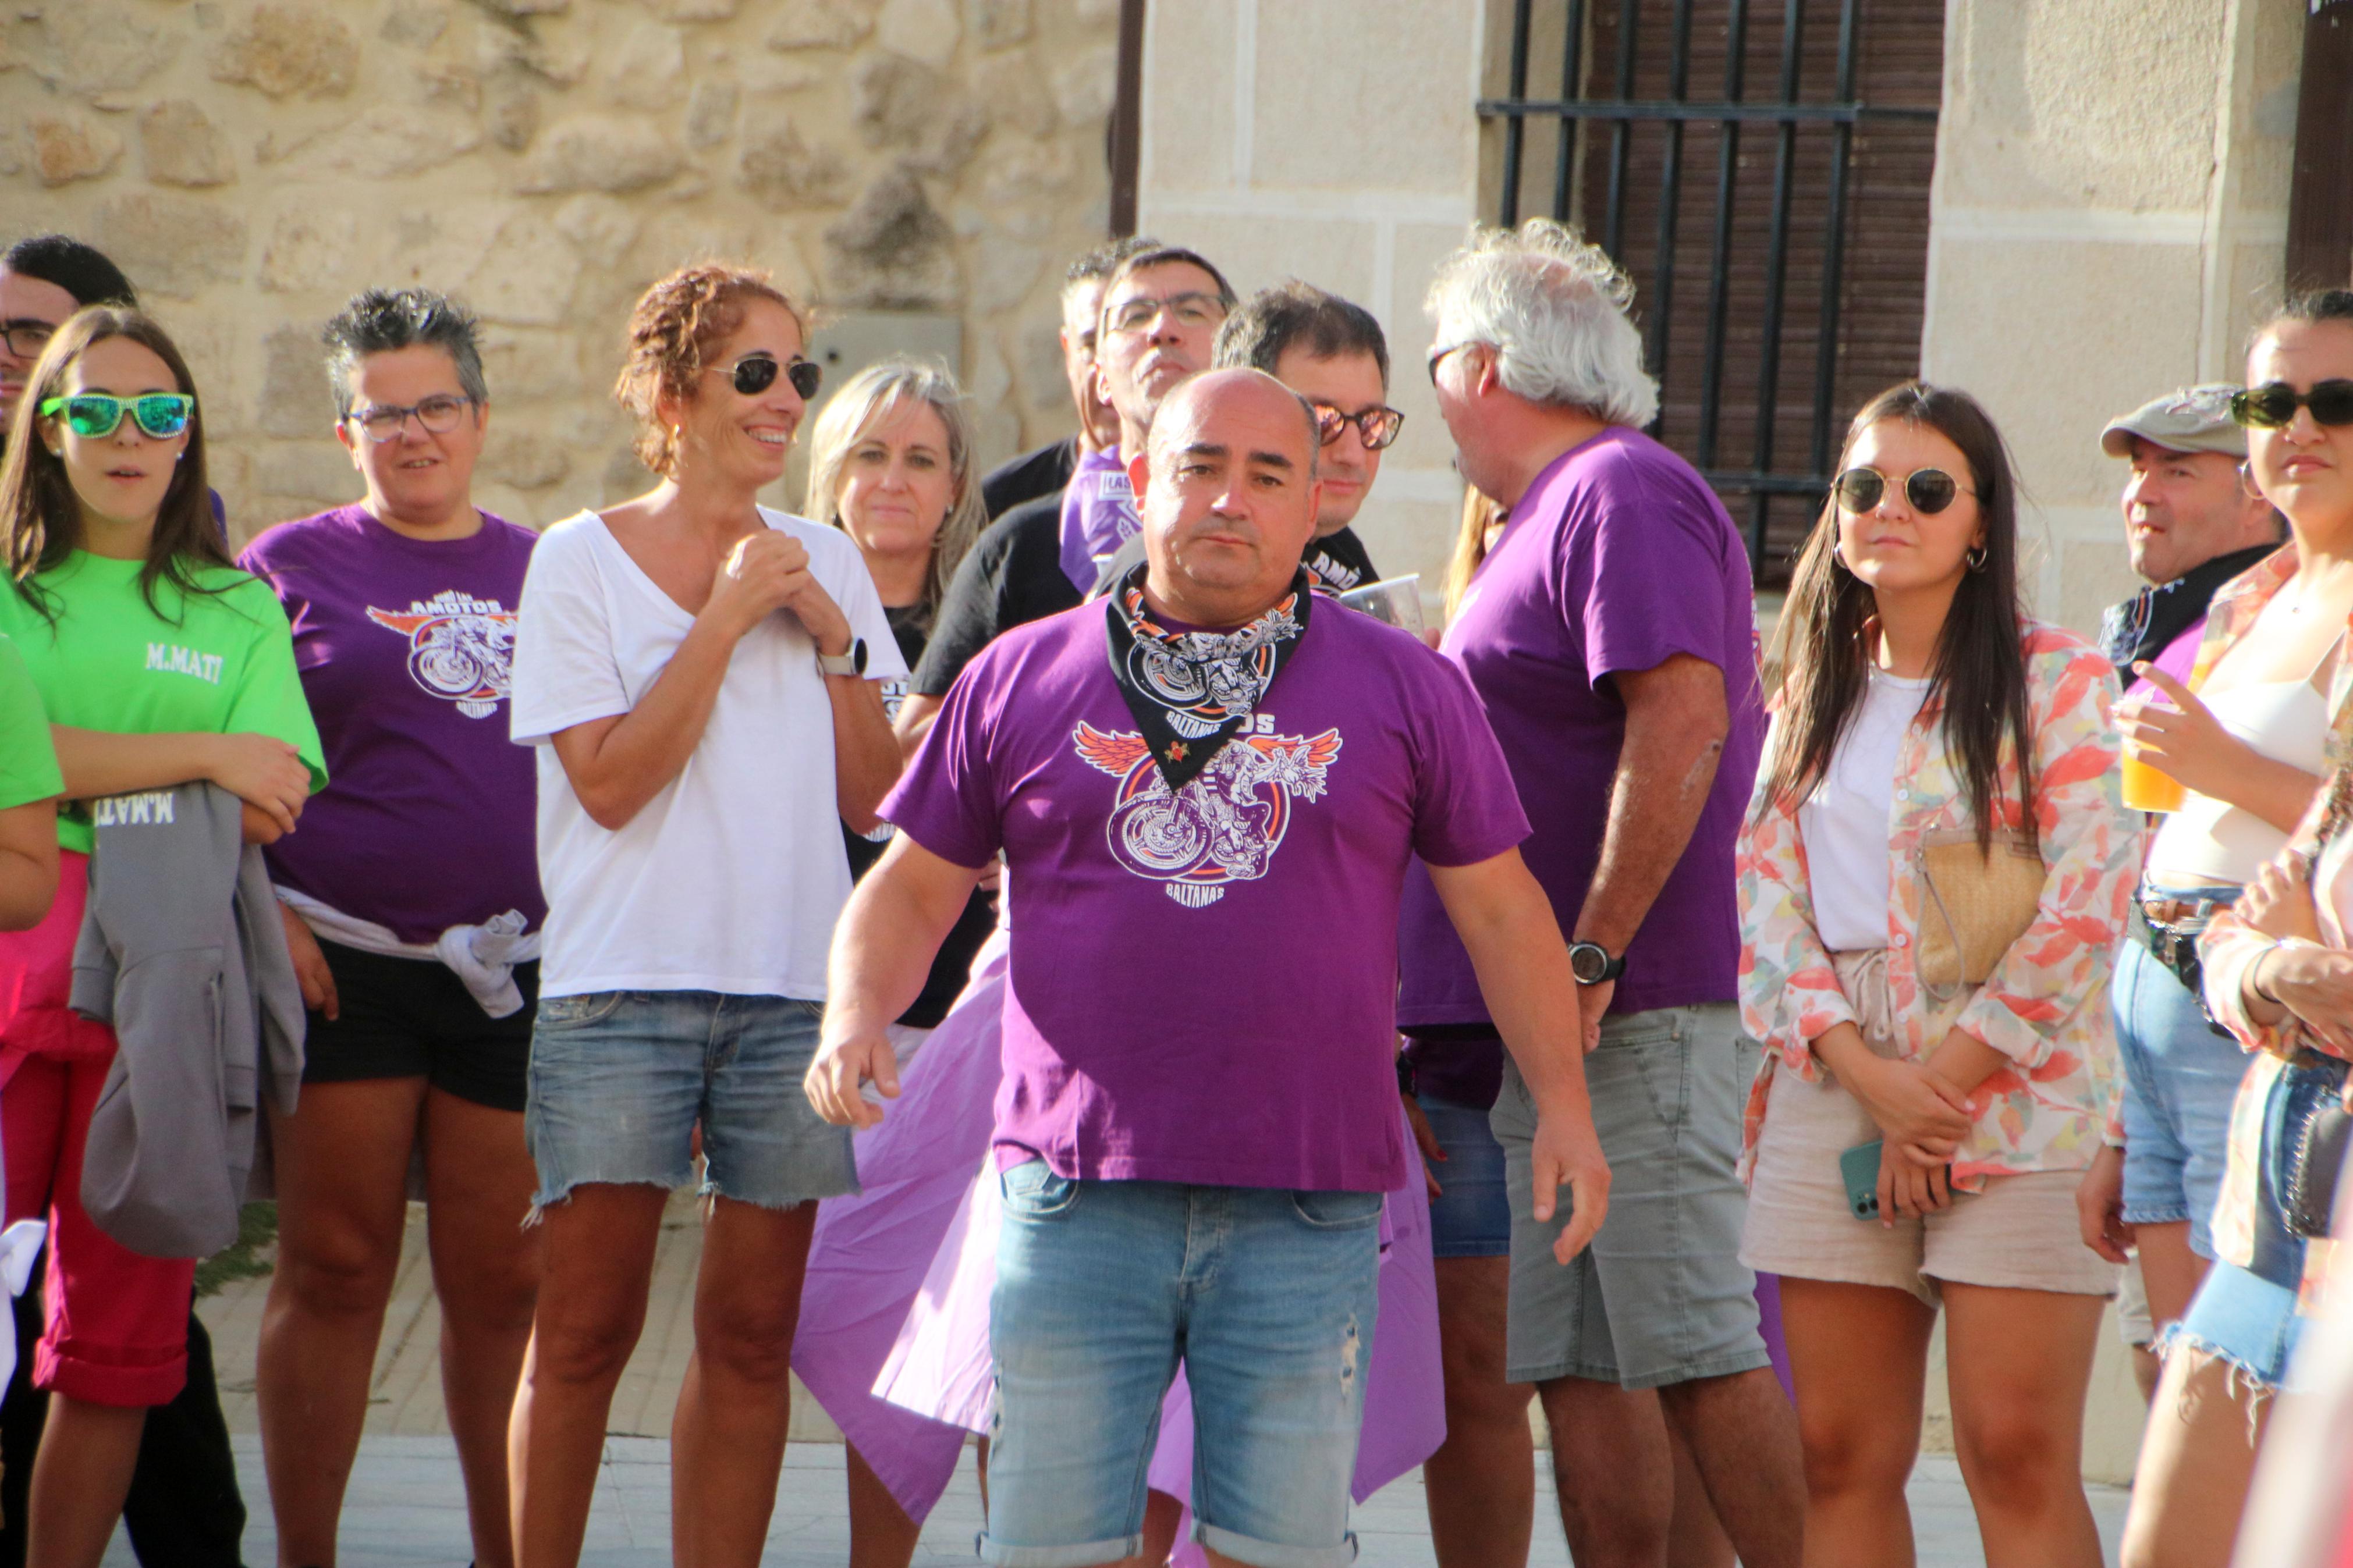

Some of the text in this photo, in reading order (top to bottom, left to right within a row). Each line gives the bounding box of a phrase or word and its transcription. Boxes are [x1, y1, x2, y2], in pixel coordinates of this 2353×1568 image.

[411, 600, 503, 614] AMOTOS
[145, 642, 223, 685] M.MATI
[94, 792, 174, 827] M.MATI
